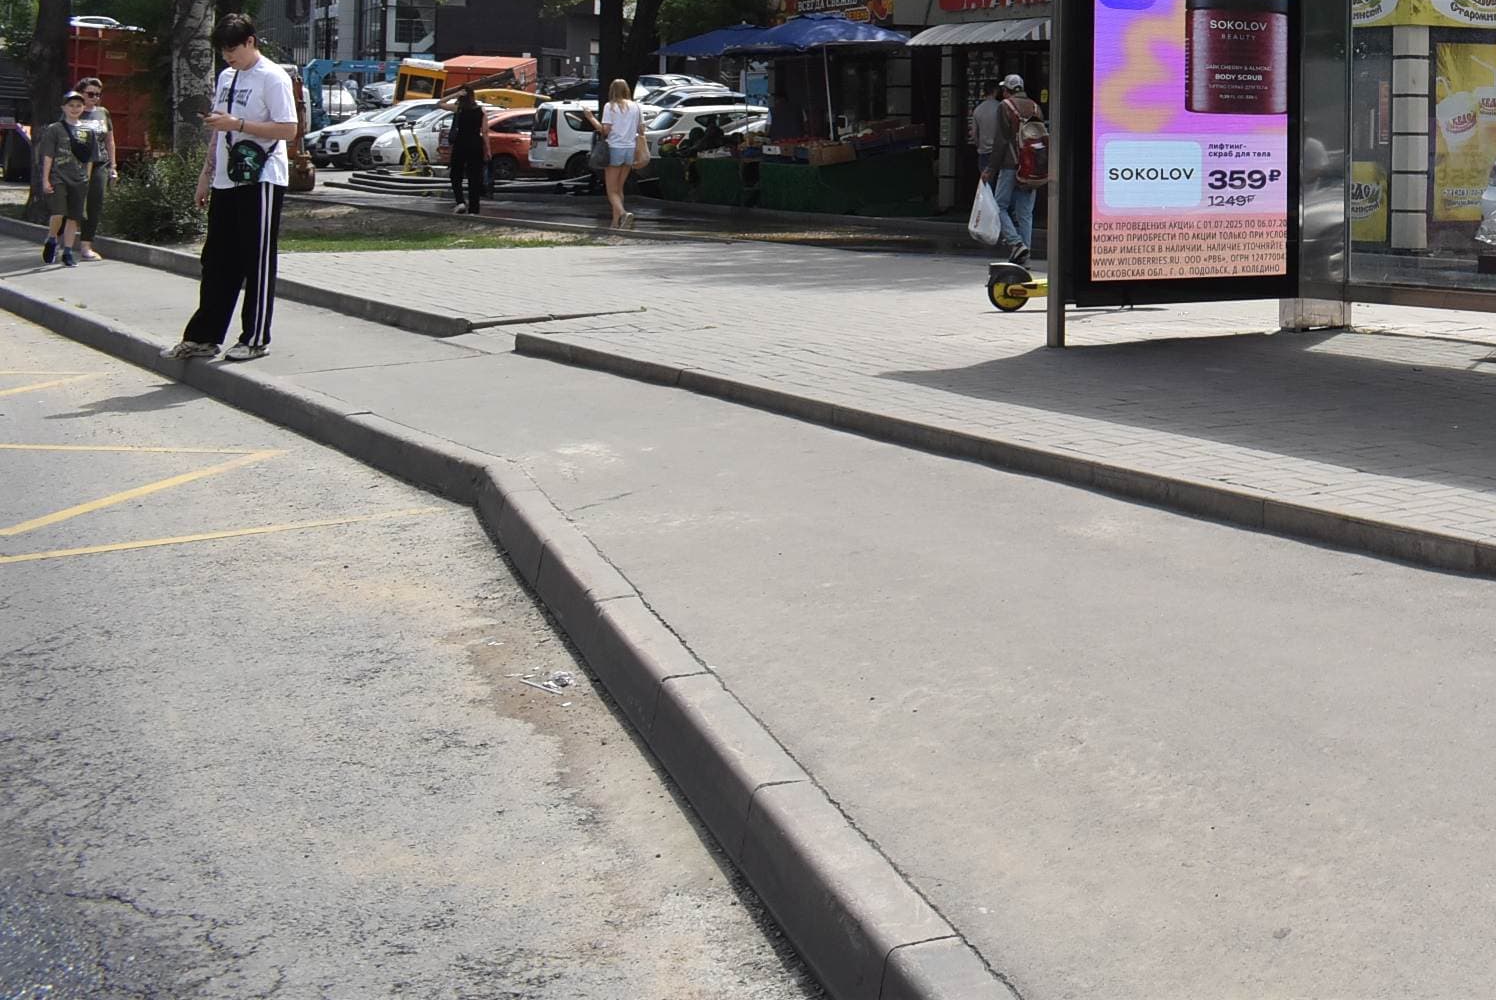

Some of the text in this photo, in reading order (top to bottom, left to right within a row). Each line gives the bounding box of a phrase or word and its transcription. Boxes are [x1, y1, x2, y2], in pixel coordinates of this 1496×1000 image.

[1209, 19, 1268, 31] SOKOLOV
[1215, 73, 1235, 81] BODY
[1208, 150, 1234, 159] скраб
[1235, 151, 1250, 159] для
[1108, 167, 1195, 181] SOKOLOV
[1115, 221, 1167, 232] ПРОВЕДЕНИЯ
[1168, 220, 1194, 230] АКЦИИ
[1203, 219, 1243, 229] 01.07.2025
[1244, 219, 1255, 229] ПО
[1093, 233, 1124, 243] МОЖНО
[1126, 232, 1176, 242] ПРИОБРЕСТИ
[1178, 232, 1190, 241] ПО
[1191, 231, 1217, 241] АКЦИИ
[1219, 230, 1248, 240] ТОЛЬКО
[1249, 230, 1264, 239] ПРИ
[1093, 245, 1119, 255] ТОВАР
[1120, 244, 1156, 254] ИМЕЕТСЯ
[1157, 244, 1163, 253] В
[1206, 242, 1240, 252] НАЛИЧИЕ
[1243, 240, 1283, 251] УТОЧНЯЙТЕ
[1184, 255, 1202, 264] ООО
[1230, 253, 1249, 263] ОГРН
[1092, 268, 1145, 279] МОСКОВСКАЯ
[1241, 264, 1280, 274] КОЛЕДИНО
